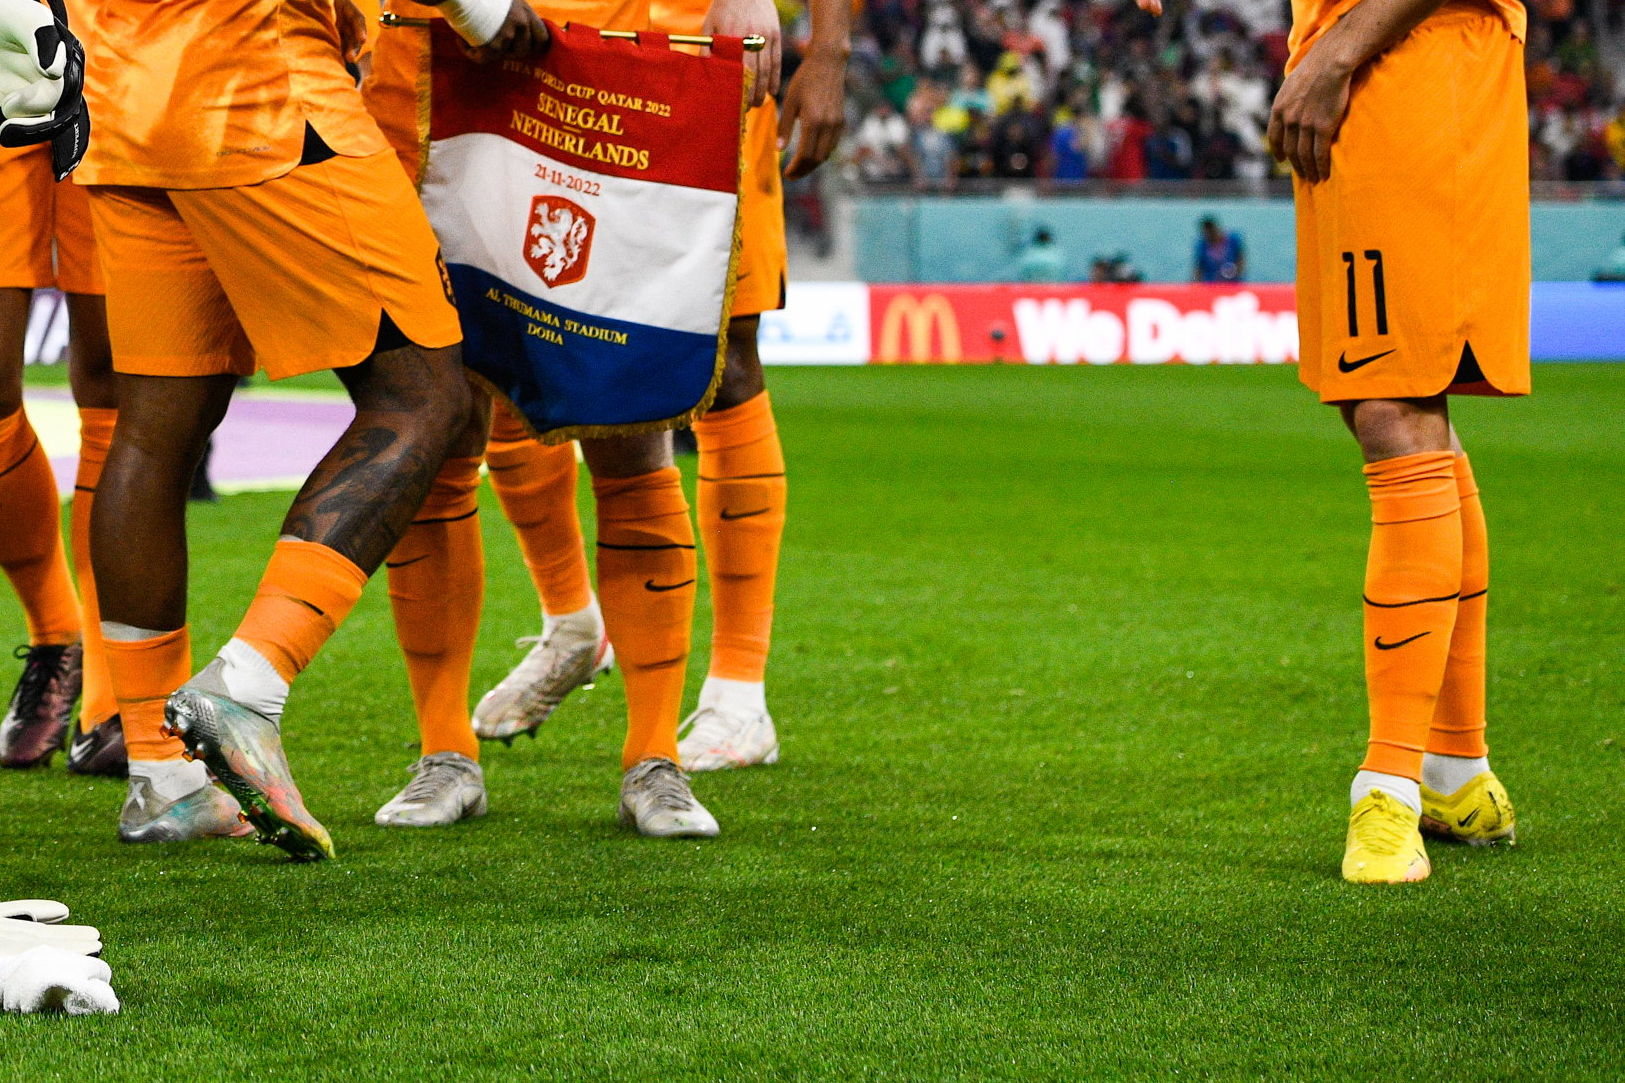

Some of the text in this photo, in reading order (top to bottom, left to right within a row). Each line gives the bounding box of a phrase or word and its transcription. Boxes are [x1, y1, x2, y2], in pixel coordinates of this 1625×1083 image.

[503, 60, 671, 118] FIFA WORLD CUP QATAR 2022
[537, 92, 623, 136] SENEGAL
[510, 109, 650, 170] NETHERLANDS
[486, 287, 629, 345] AL THUMAMA STADIUM
[1342, 250, 1388, 337] 11
[527, 322, 564, 346] DOHA
